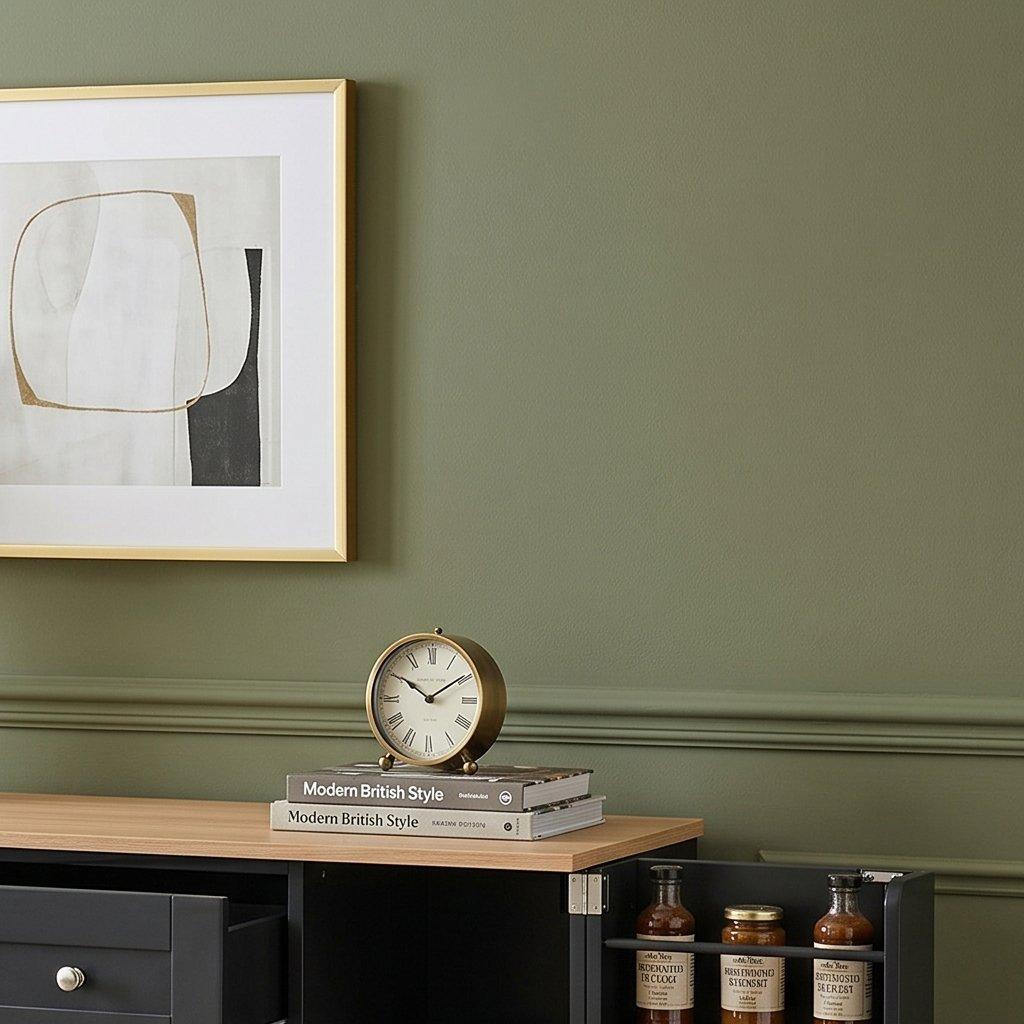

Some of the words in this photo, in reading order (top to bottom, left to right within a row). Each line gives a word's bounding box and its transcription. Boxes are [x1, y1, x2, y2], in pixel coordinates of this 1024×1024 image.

[302, 781, 358, 797] Modern
[360, 783, 405, 800] British
[408, 785, 445, 804] Style
[288, 810, 338, 825] Modern
[341, 812, 384, 828] British
[386, 814, 420, 831] Style
